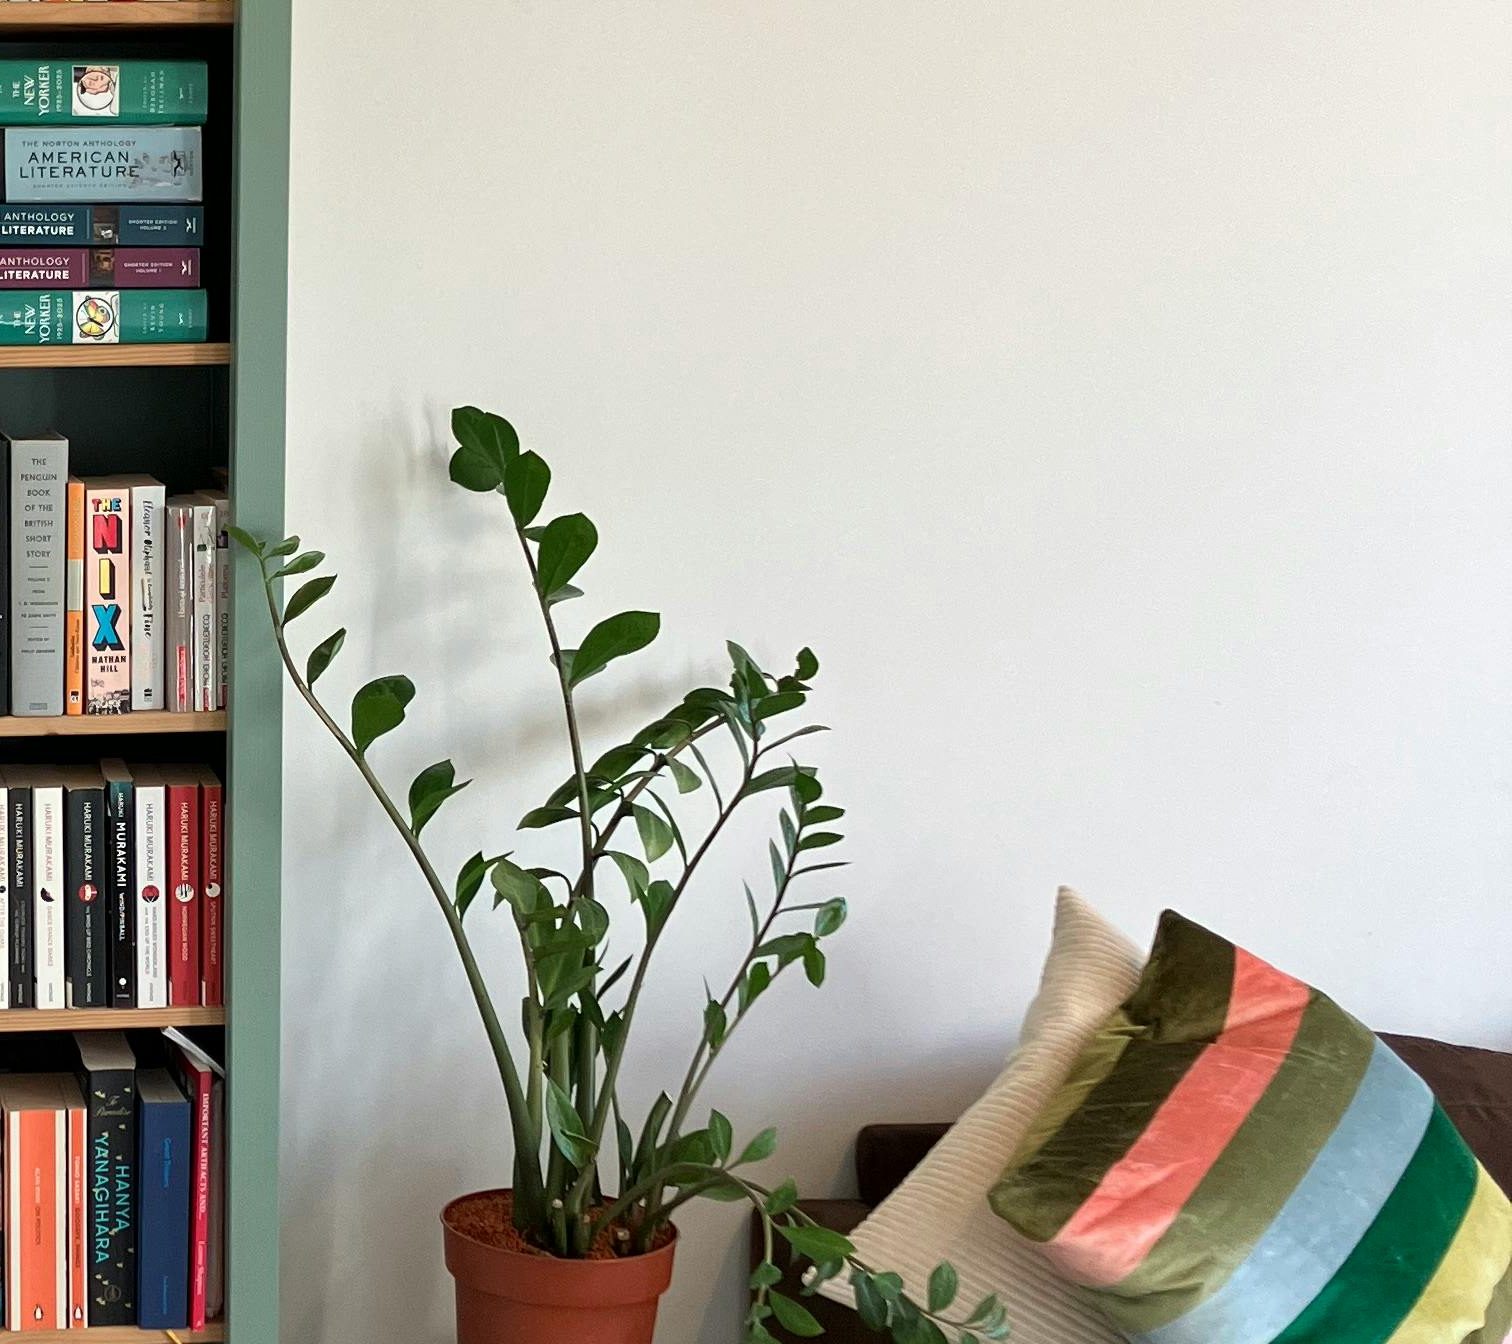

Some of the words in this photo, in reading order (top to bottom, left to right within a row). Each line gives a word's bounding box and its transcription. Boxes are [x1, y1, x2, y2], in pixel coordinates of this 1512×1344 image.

[24, 74, 35, 106] NEW
[38, 65, 50, 117] YORKER
[19, 166, 139, 179] LITERATURE
[28, 151, 130, 163] AMERICAN
[1, 226, 74, 235] LITERATURE
[4, 213, 75, 222] ANTHOLOGY
[0, 257, 70, 266] ANTHOLOGY
[180, 802, 189, 834] HARUKI
[116, 822, 127, 887] MURAKAMI
[180, 835, 189, 881] MURAKAMI
[95, 1134, 110, 1264] YANAGIHARA
[115, 1165, 130, 1231] HANYA
